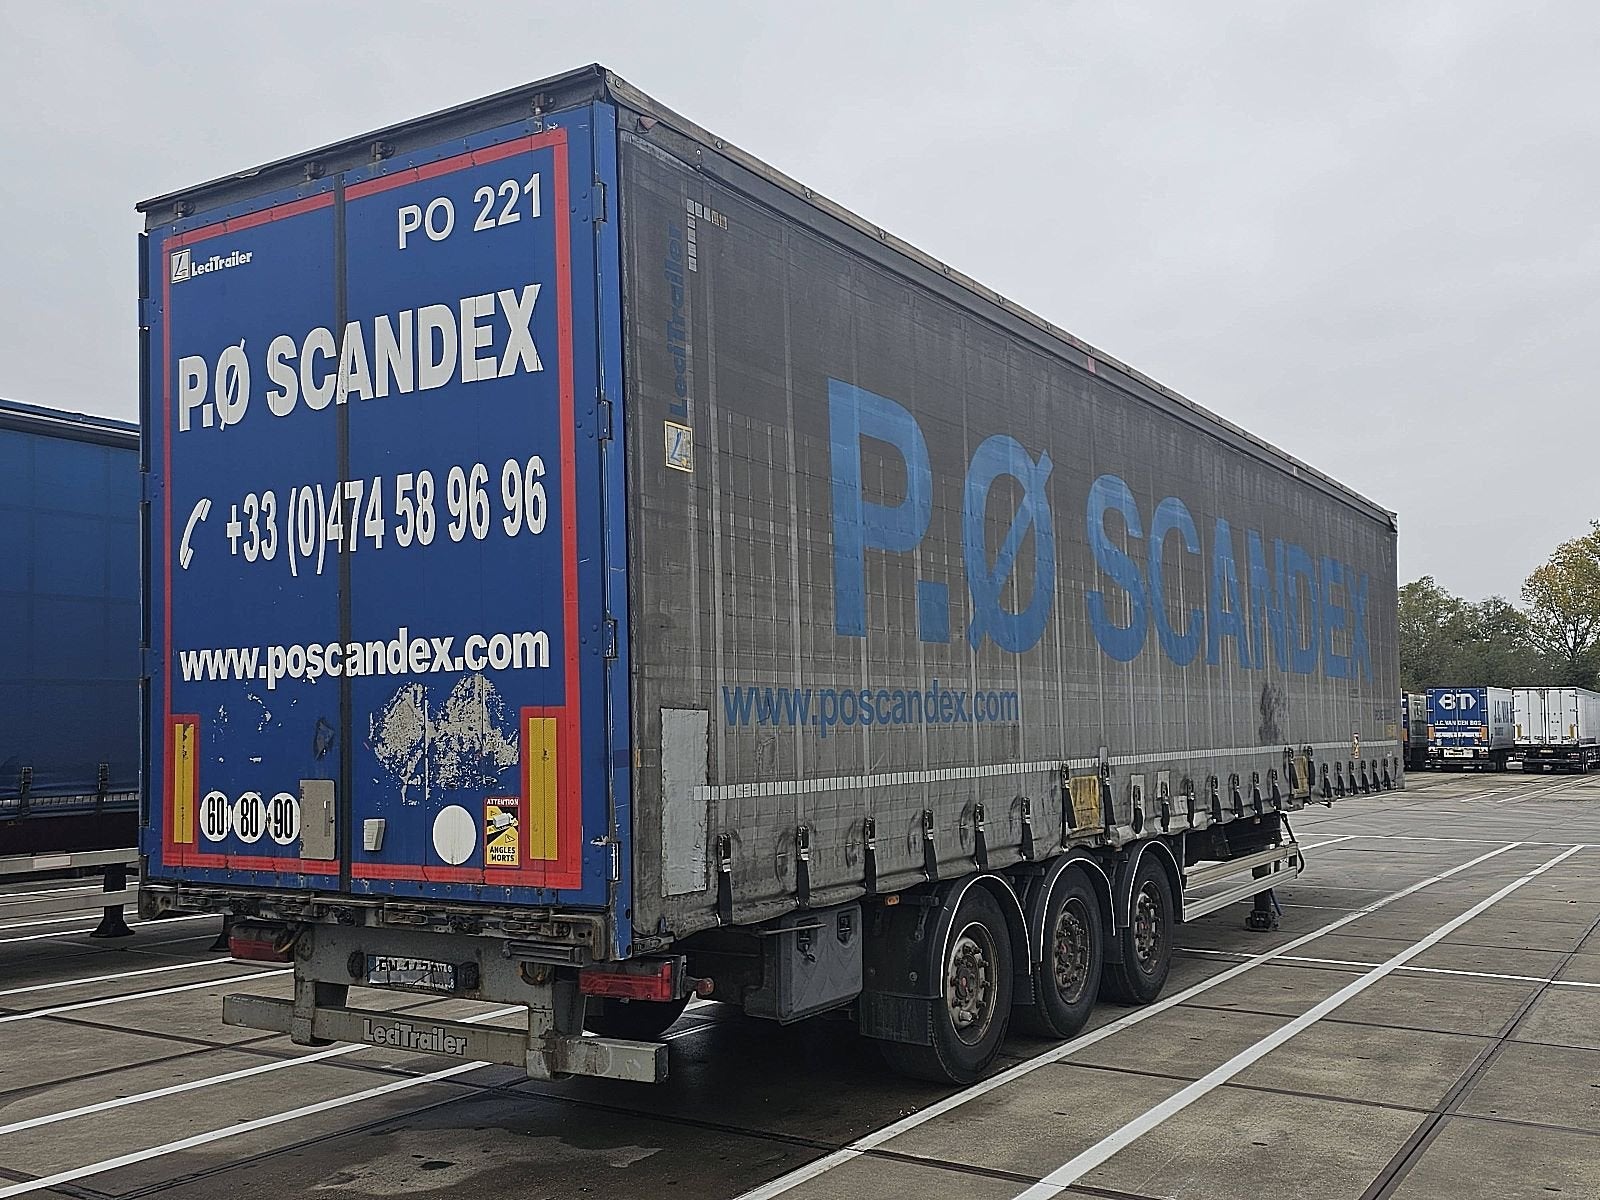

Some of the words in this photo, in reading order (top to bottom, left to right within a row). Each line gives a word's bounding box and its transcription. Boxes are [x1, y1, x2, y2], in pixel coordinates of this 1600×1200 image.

[399, 197, 455, 249] PO
[473, 172, 541, 232] 221
[191, 250, 253, 277] LeciTrailer
[179, 337, 250, 432] P.Ø
[265, 283, 544, 418] SCANDEX
[226, 490, 277, 562] +33
[287, 475, 384, 577] (0)474
[395, 469, 435, 547] 58
[447, 463, 490, 542] 96
[501, 455, 547, 537] 96
[1085, 473, 1373, 685] SCANDEX
[180, 627, 549, 690] www.poscandex.com
[721, 679, 1020, 739] www.poscandex.com
[207, 796, 225, 836] 60
[240, 797, 259, 838] 80
[273, 798, 294, 839] 90
[486, 798, 519, 806] ATTENTION
[489, 846, 516, 854] ANGLES
[491, 854, 515, 862] MORTS
[362, 1018, 468, 1056] LeciTrailer
